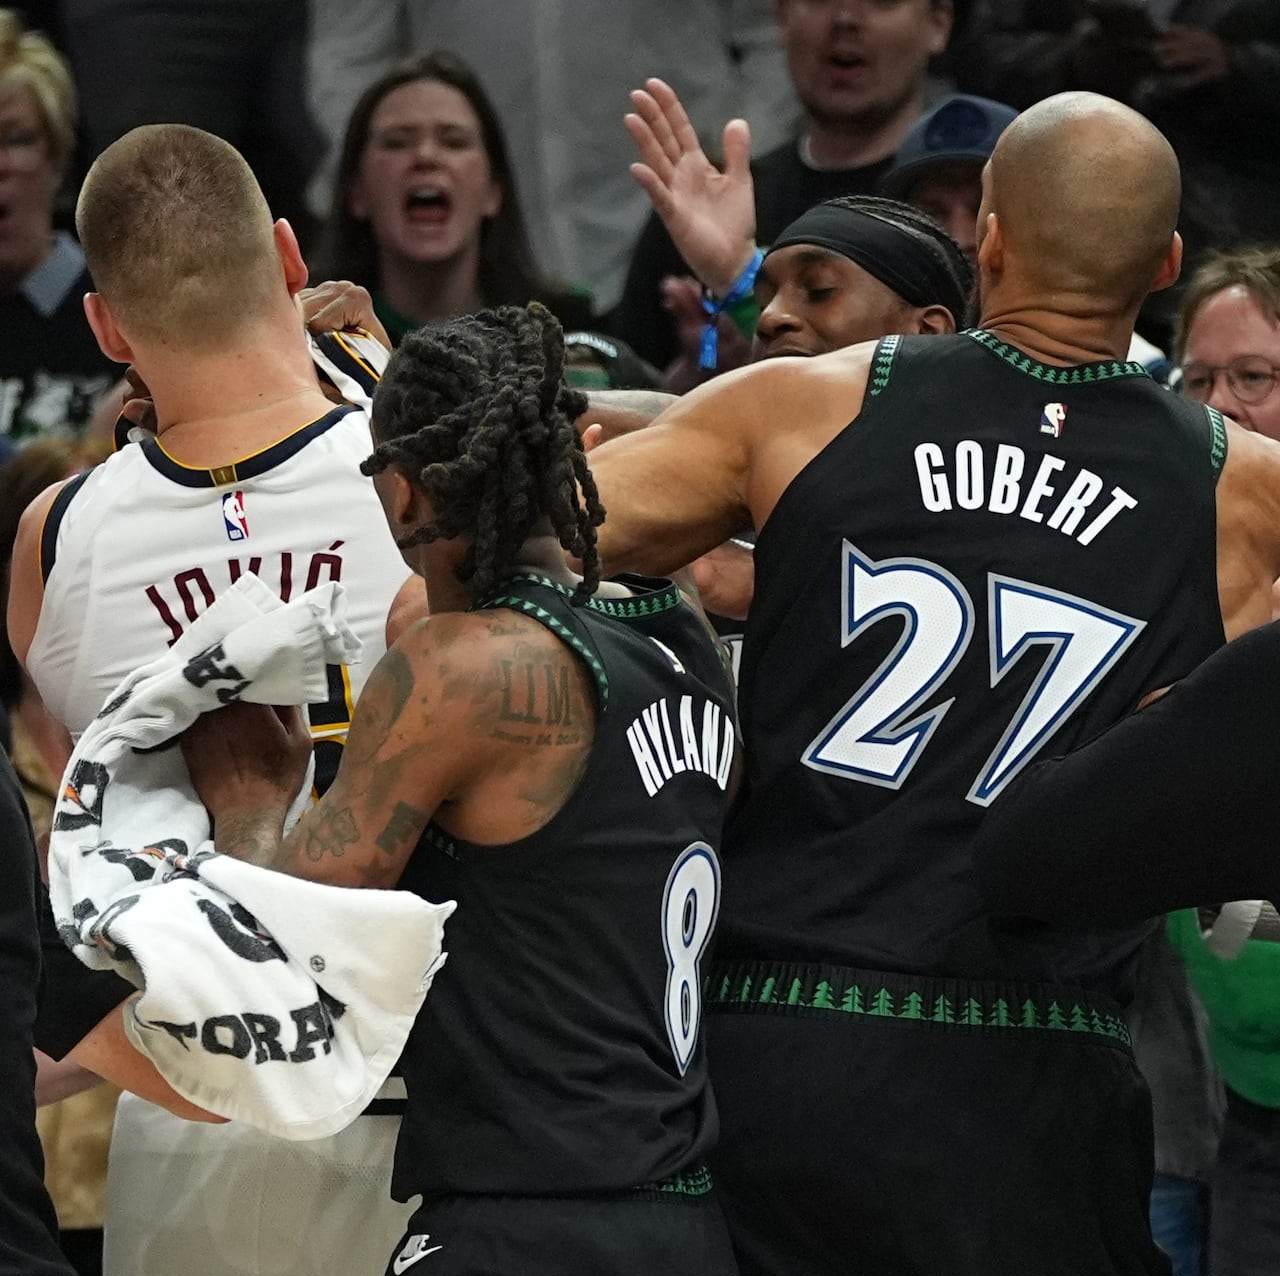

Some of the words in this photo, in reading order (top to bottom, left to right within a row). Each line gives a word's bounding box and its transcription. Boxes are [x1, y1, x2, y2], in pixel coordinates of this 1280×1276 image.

[914, 439, 1138, 546] GOBERT
[800, 537, 1148, 808] 27
[625, 694, 735, 798] HYLAND
[661, 840, 721, 1078] 8
[148, 988, 346, 1066] TORA
